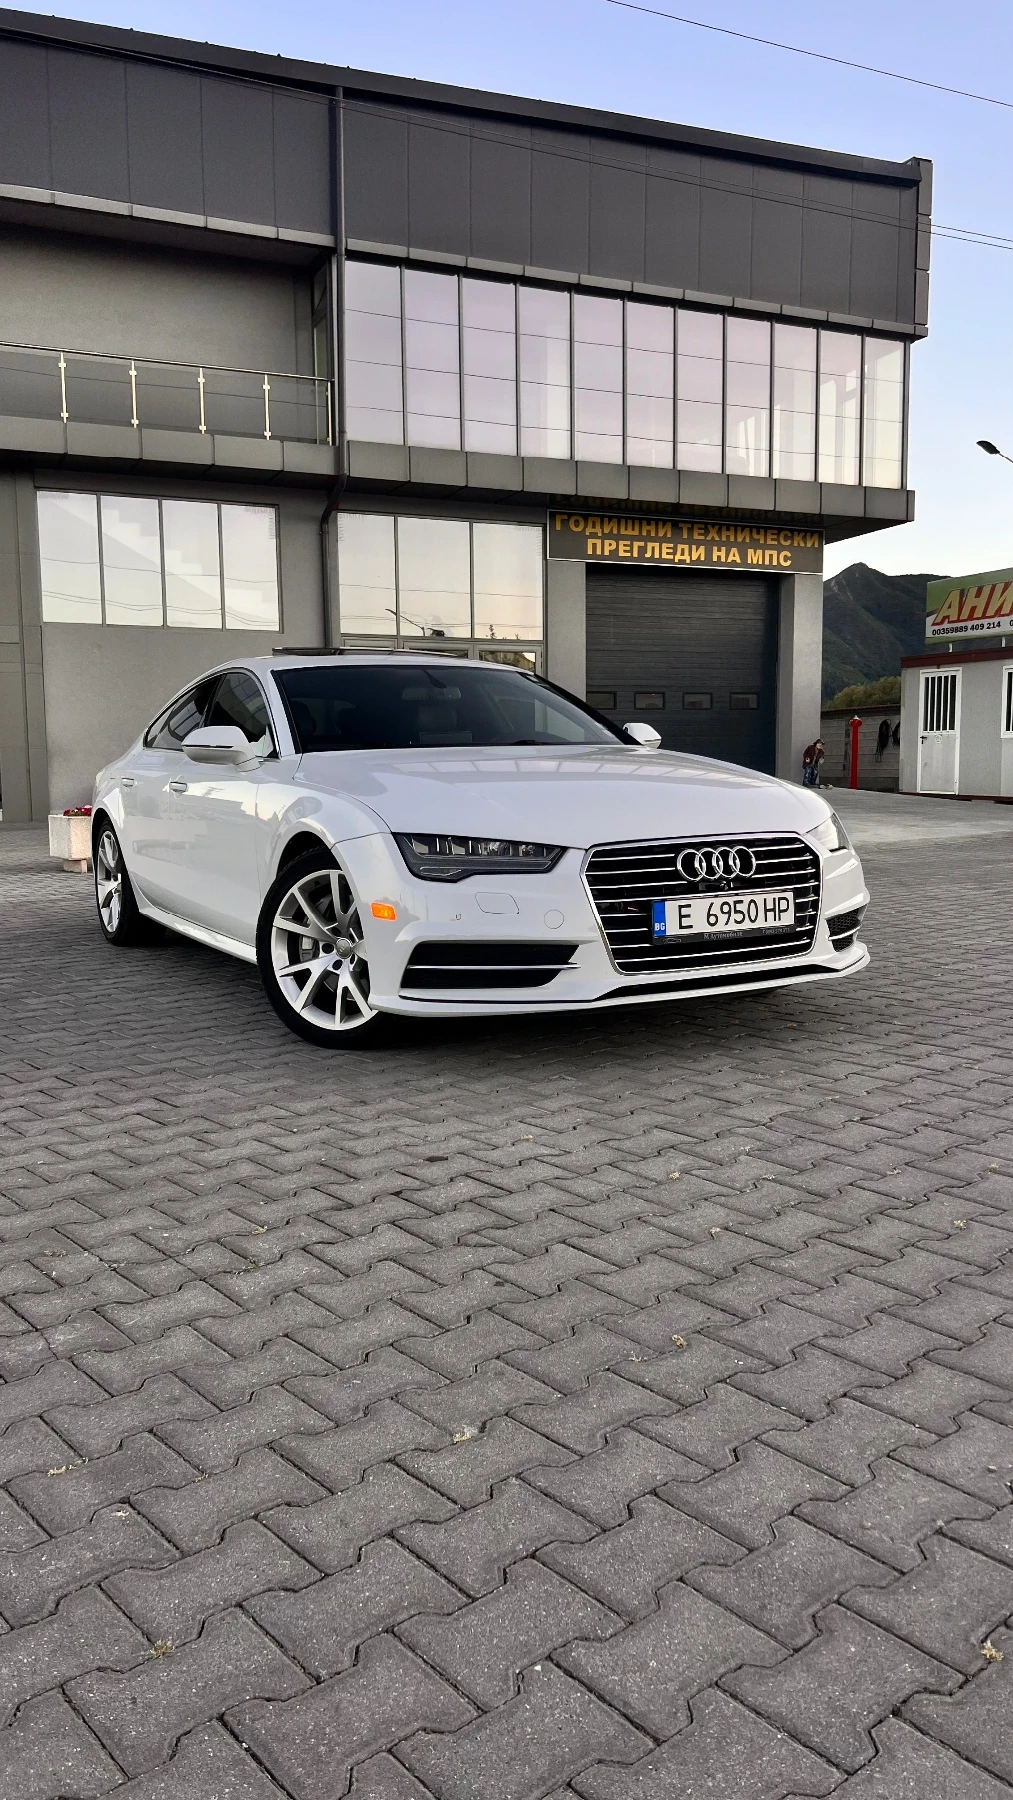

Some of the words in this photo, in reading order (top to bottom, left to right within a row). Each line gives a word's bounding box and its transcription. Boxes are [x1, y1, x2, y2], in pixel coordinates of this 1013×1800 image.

[555, 514, 672, 538] ГОДИШНИ
[678, 522, 819, 548] ТЕХНИЧЕСКИ
[587, 539, 705, 563] ПРЕГЛЕДИ
[712, 546, 741, 564] НА
[747, 549, 792, 567] МПС
[932, 625, 968, 636] 00359889
[970, 623, 984, 632] 409
[986, 620, 1001, 630] 214
[655, 922, 665, 931] BG
[677, 903, 694, 930] E
[706, 899, 759, 927] 6950
[763, 896, 790, 923] HP
